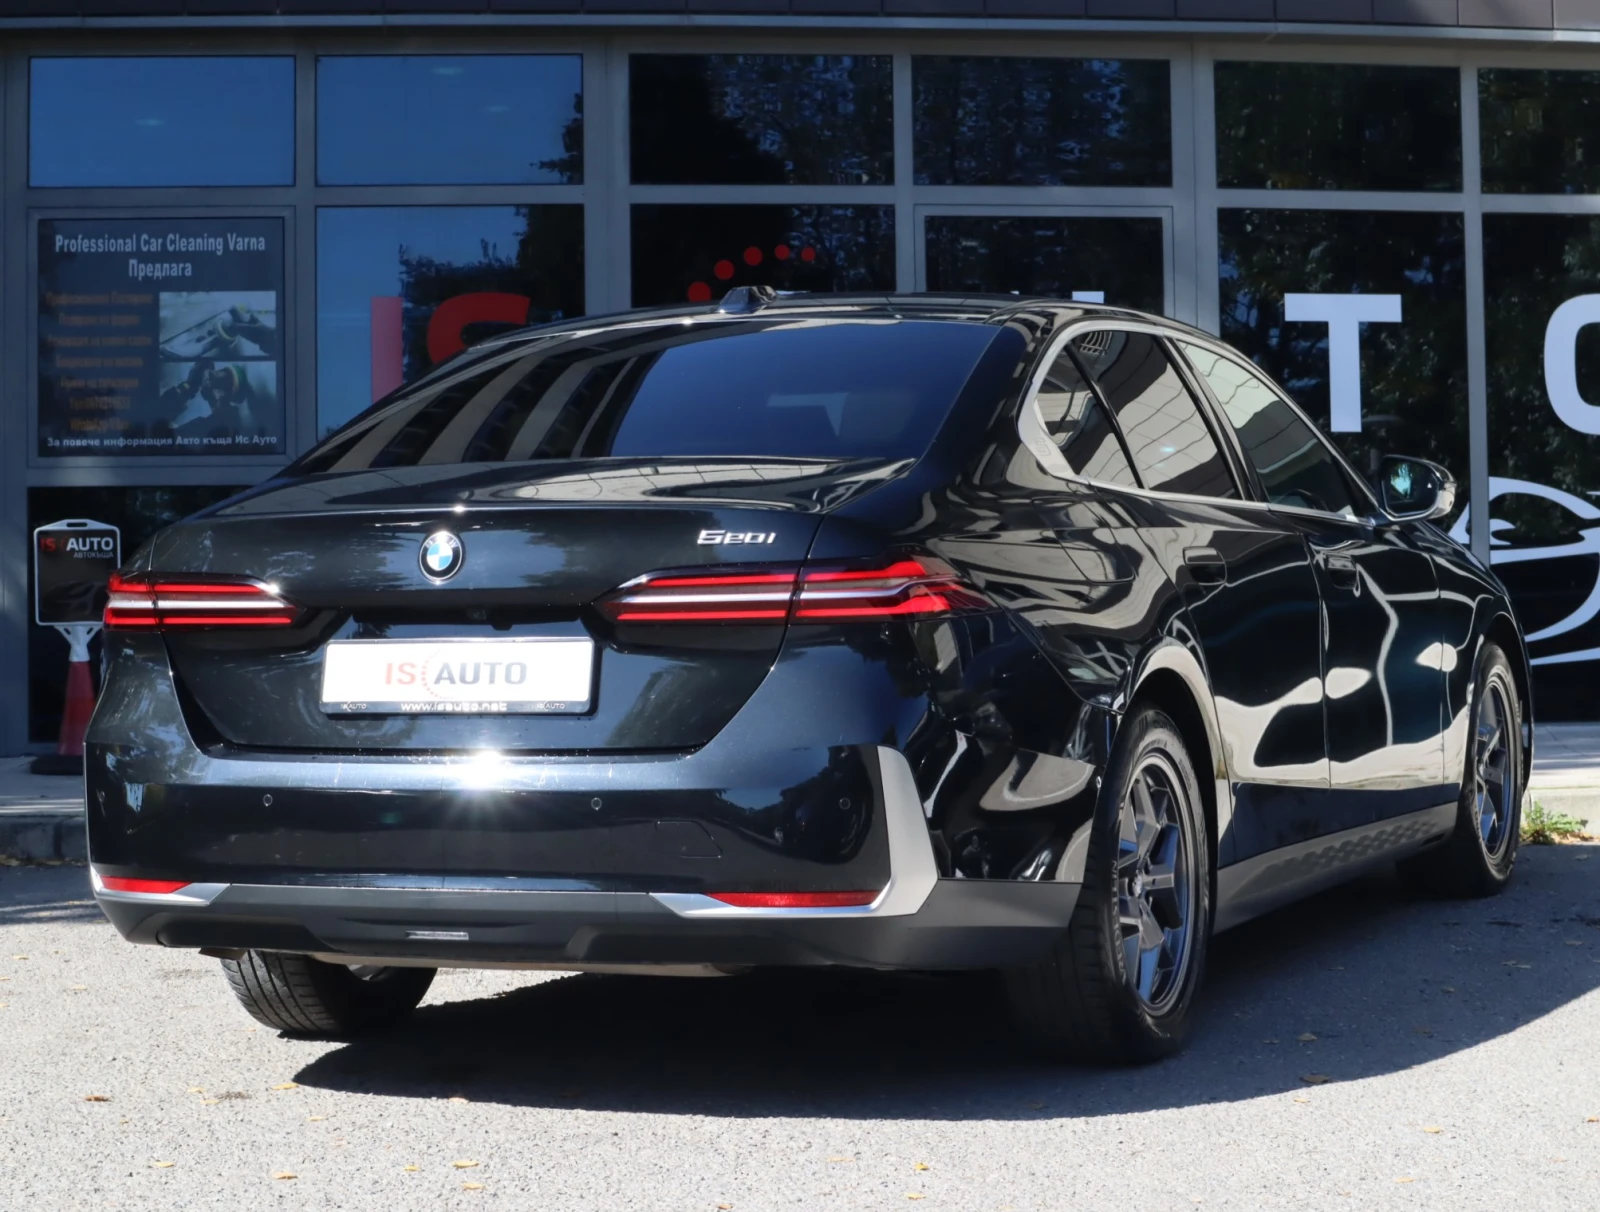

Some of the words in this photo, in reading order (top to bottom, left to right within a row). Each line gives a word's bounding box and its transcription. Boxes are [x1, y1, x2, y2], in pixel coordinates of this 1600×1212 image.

[55, 233, 136, 252] Professional
[140, 233, 162, 252] Car
[166, 233, 223, 255] Cleaning
[227, 233, 265, 251] Varna
[128, 259, 192, 280] Предлага
[47, 437, 60, 447] За
[63, 438, 100, 447] повече
[103, 436, 172, 447] информация
[176, 435, 200, 445] Авто
[203, 437, 232, 446] къща
[235, 435, 249, 444] Ис
[252, 435, 277, 446] Ауто
[40, 537, 56, 552] IS
[66, 537, 114, 551] AUTO
[385, 662, 417, 685] IS
[433, 662, 527, 685] AUTO
